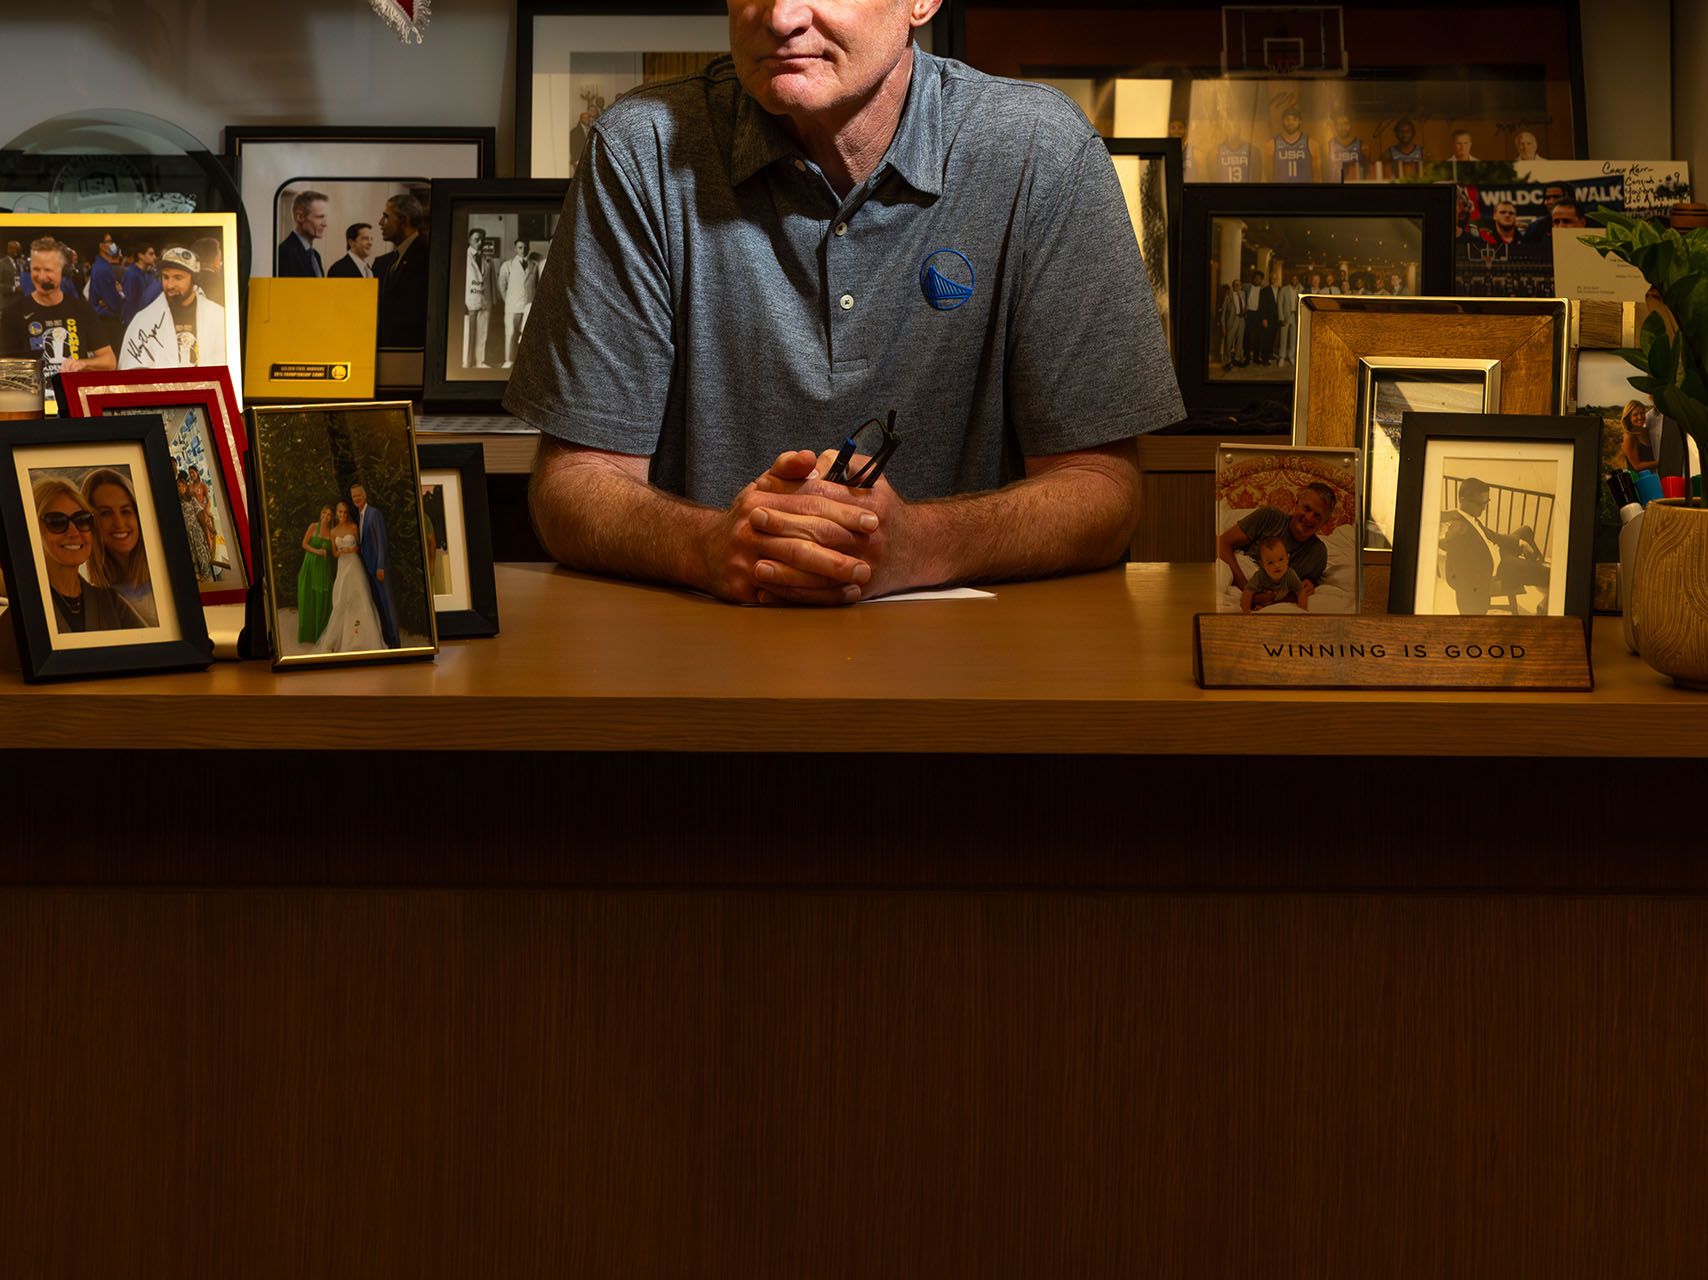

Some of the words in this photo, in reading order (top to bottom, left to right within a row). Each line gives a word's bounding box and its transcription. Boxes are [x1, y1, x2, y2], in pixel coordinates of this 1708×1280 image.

[1278, 150, 1305, 160] USA
[1287, 161, 1298, 177] 11
[1574, 184, 1624, 202] WALK
[1263, 643, 1387, 658] WINNING
[1404, 643, 1428, 658] IS
[1445, 644, 1527, 659] GOOD
